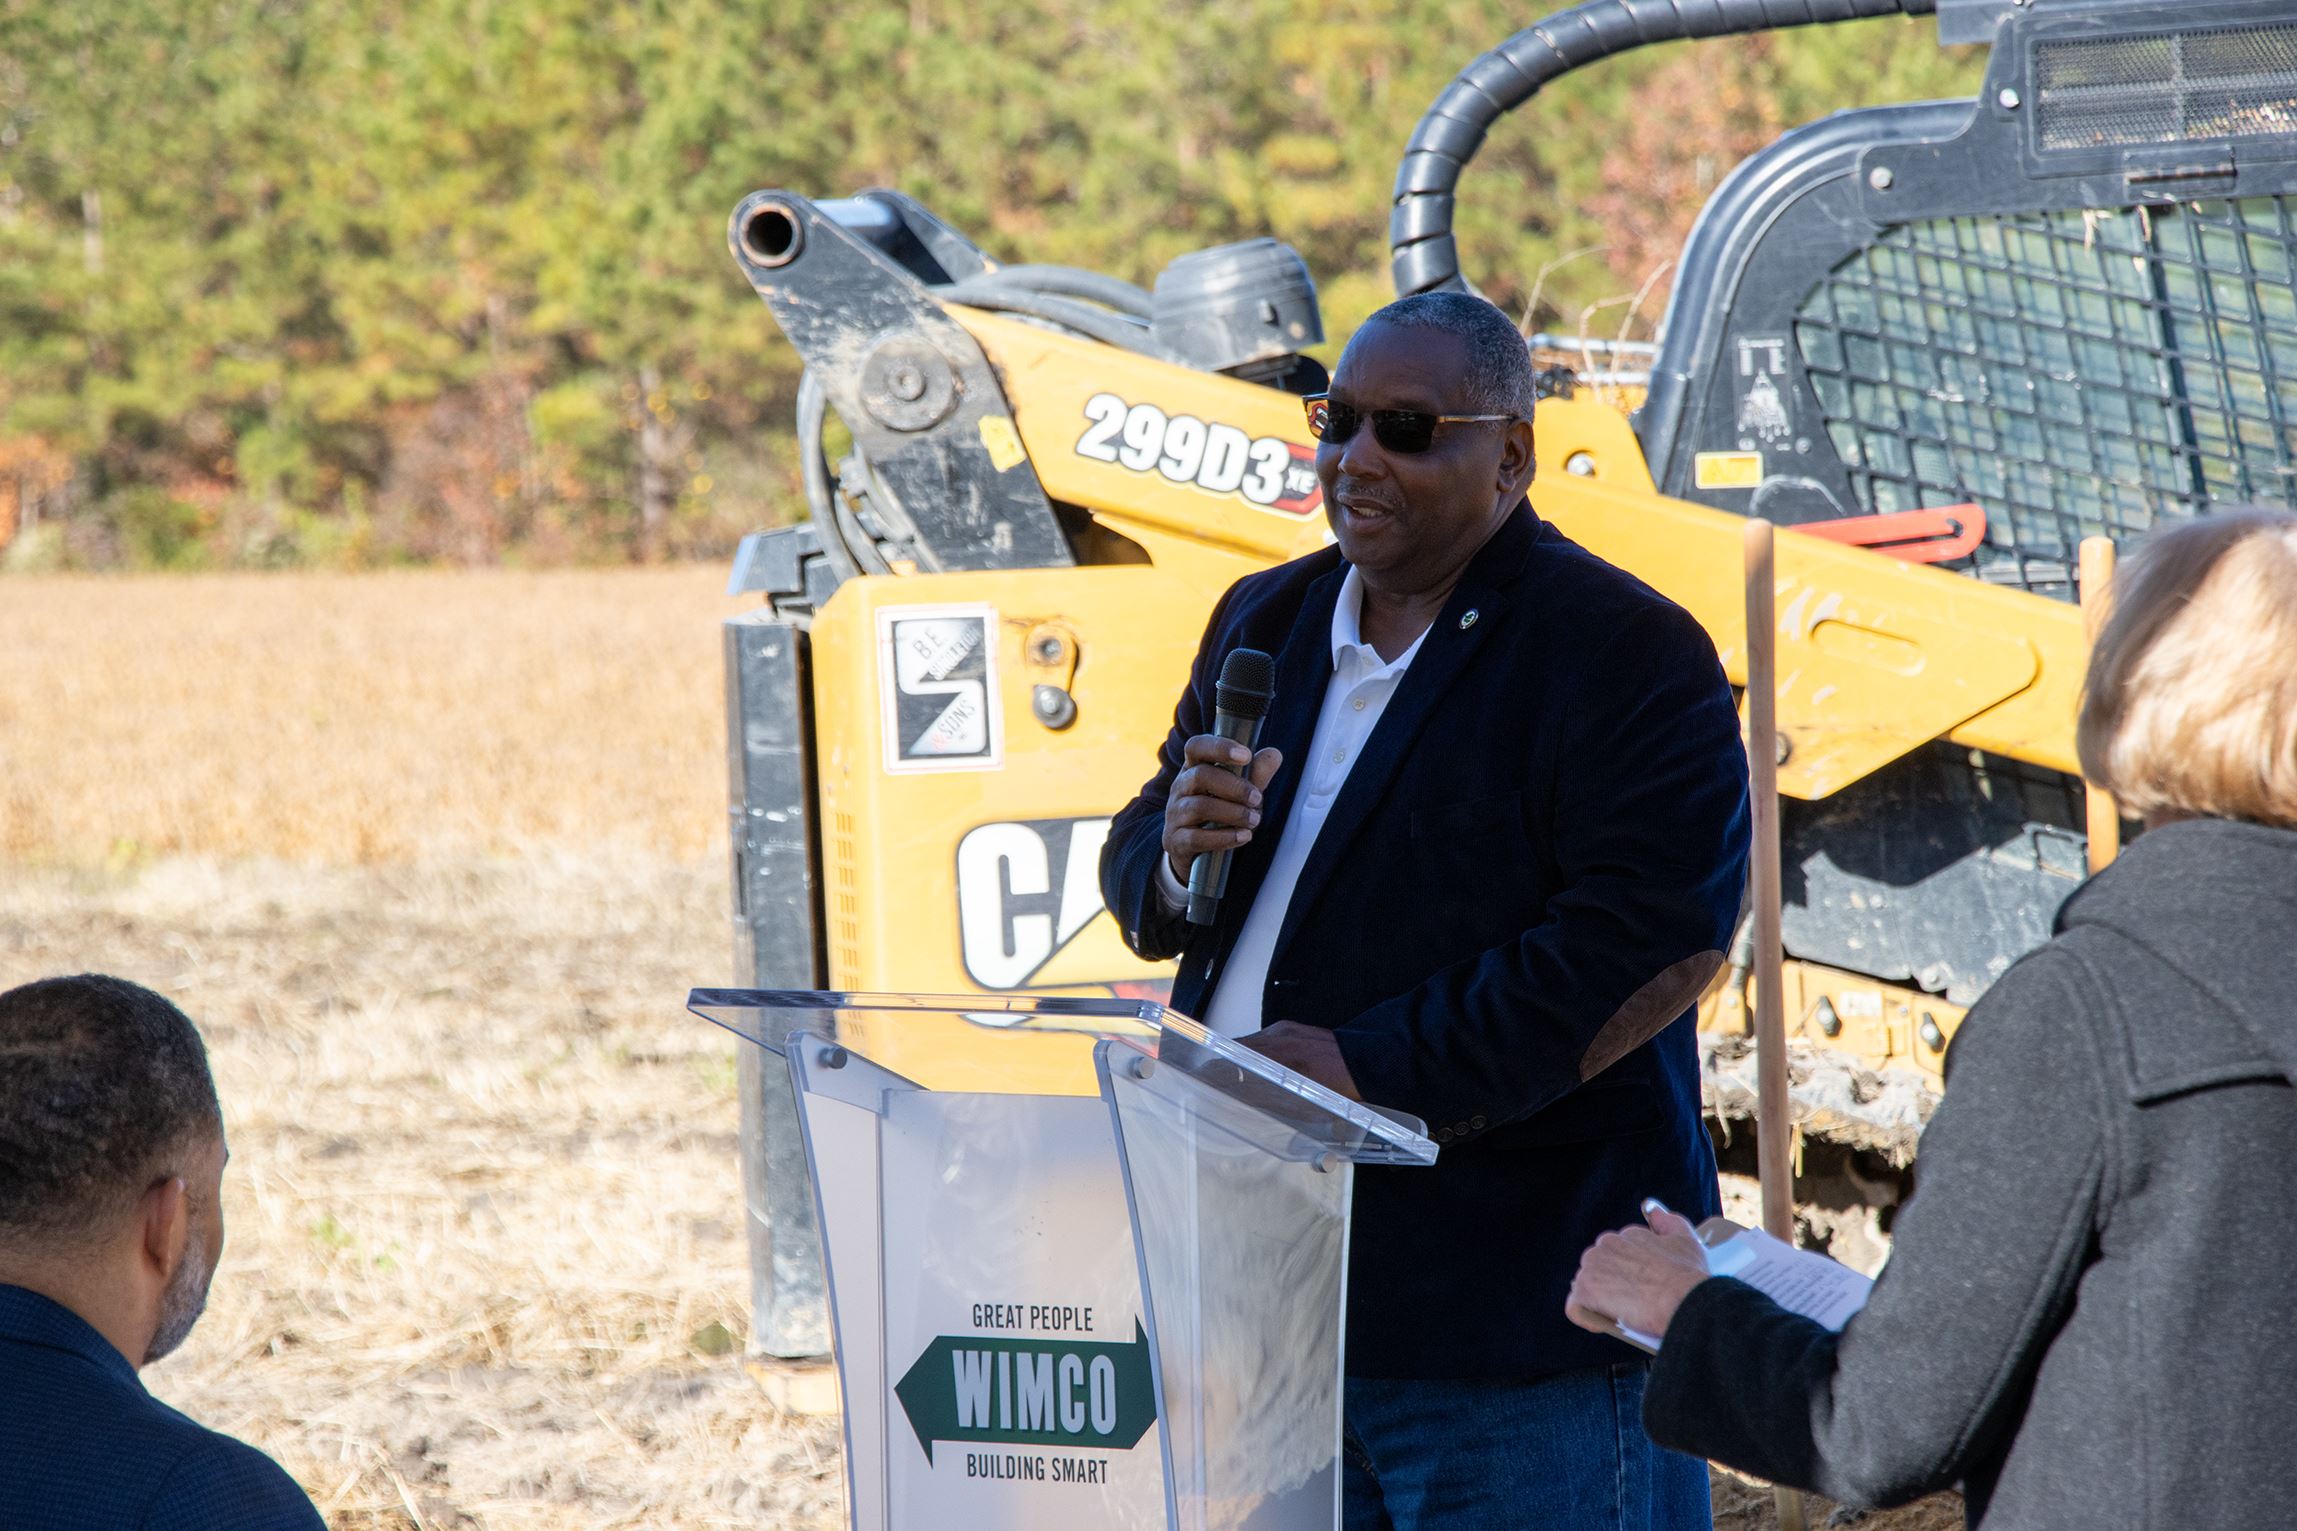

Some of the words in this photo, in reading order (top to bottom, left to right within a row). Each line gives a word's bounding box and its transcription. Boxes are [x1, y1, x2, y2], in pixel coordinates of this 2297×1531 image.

[1075, 392, 1290, 504] 299D3
[937, 699, 976, 739] SONS
[957, 819, 1113, 989] CA
[973, 1303, 1024, 1330] GREAT
[1030, 1305, 1094, 1332] PEOPLE
[951, 1349, 1117, 1436] WIMCO
[966, 1453, 1046, 1482] BUILDING
[1051, 1457, 1108, 1485] SMART
